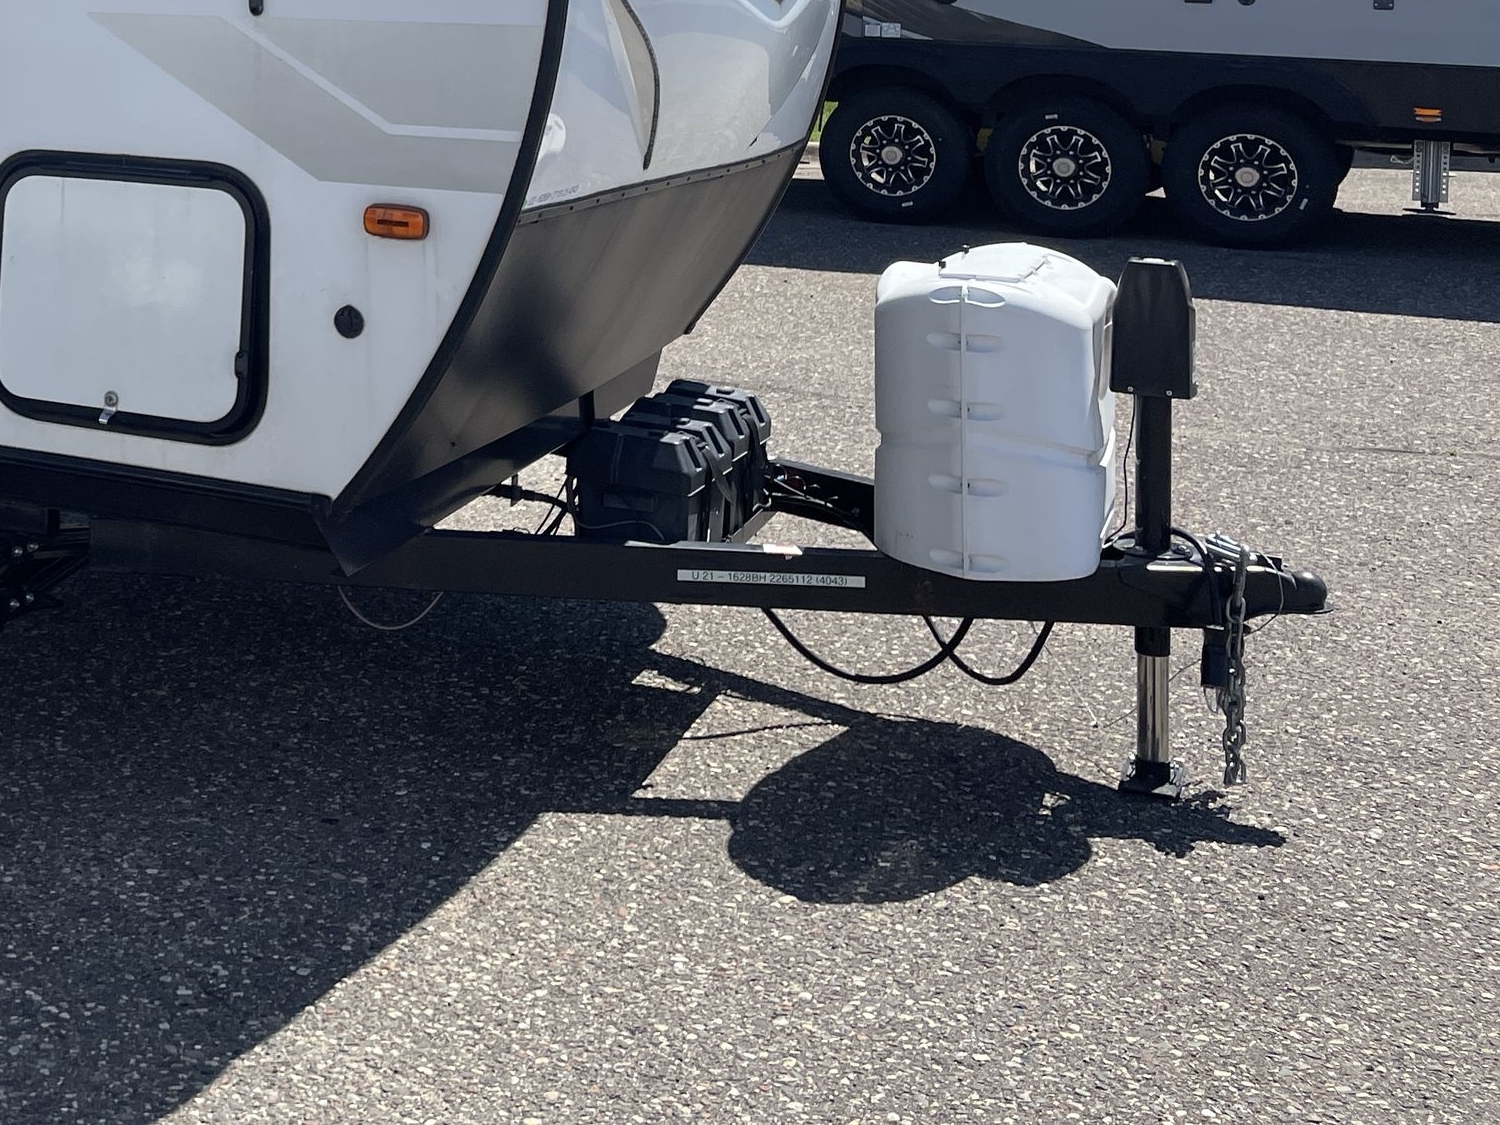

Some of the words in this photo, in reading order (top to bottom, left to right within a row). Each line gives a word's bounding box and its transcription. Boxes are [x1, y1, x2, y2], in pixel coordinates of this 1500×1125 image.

[691, 571, 699, 581] U
[703, 572, 714, 581] 21
[728, 572, 767, 583] 1628BH
[769, 573, 813, 584] 2265112
